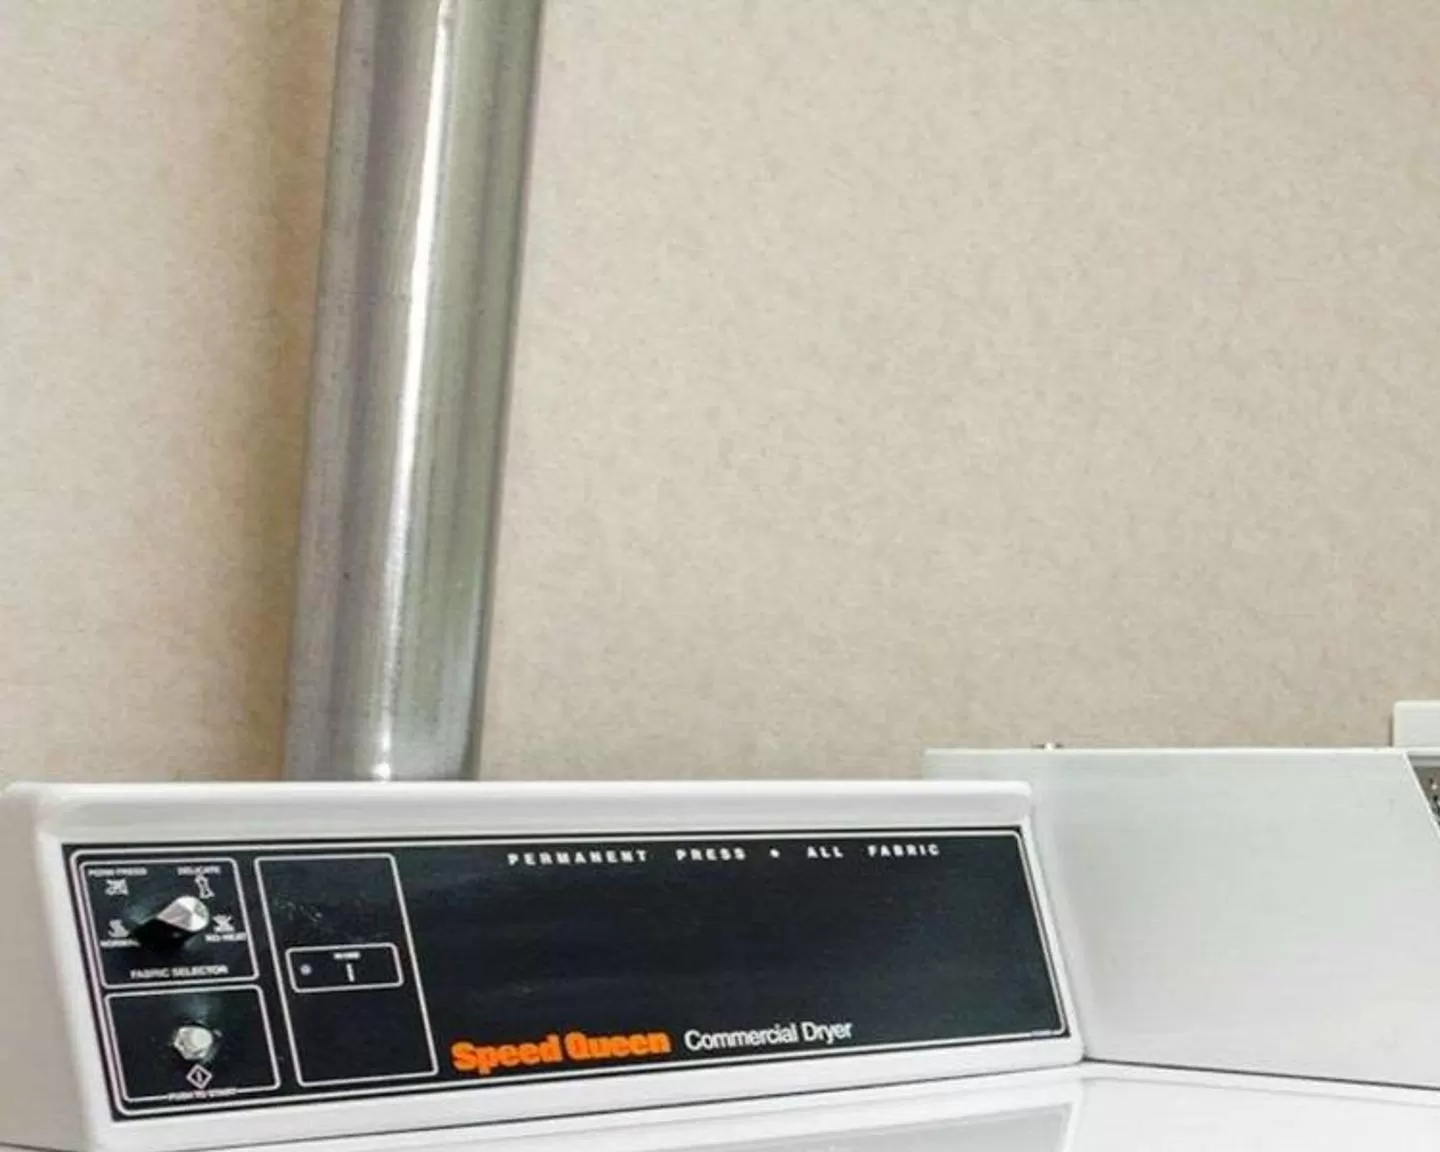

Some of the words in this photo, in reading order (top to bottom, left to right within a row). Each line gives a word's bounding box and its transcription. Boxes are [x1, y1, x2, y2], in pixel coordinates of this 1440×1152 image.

[507, 849, 648, 867] PERMANENT
[676, 847, 746, 862] PRESS
[806, 846, 843, 859] ALL
[867, 843, 940, 857] FABRIC
[451, 1035, 561, 1073] Speed
[566, 1031, 670, 1062] Queen
[685, 1023, 797, 1052] Commercial
[802, 1020, 855, 1046] Dryer
